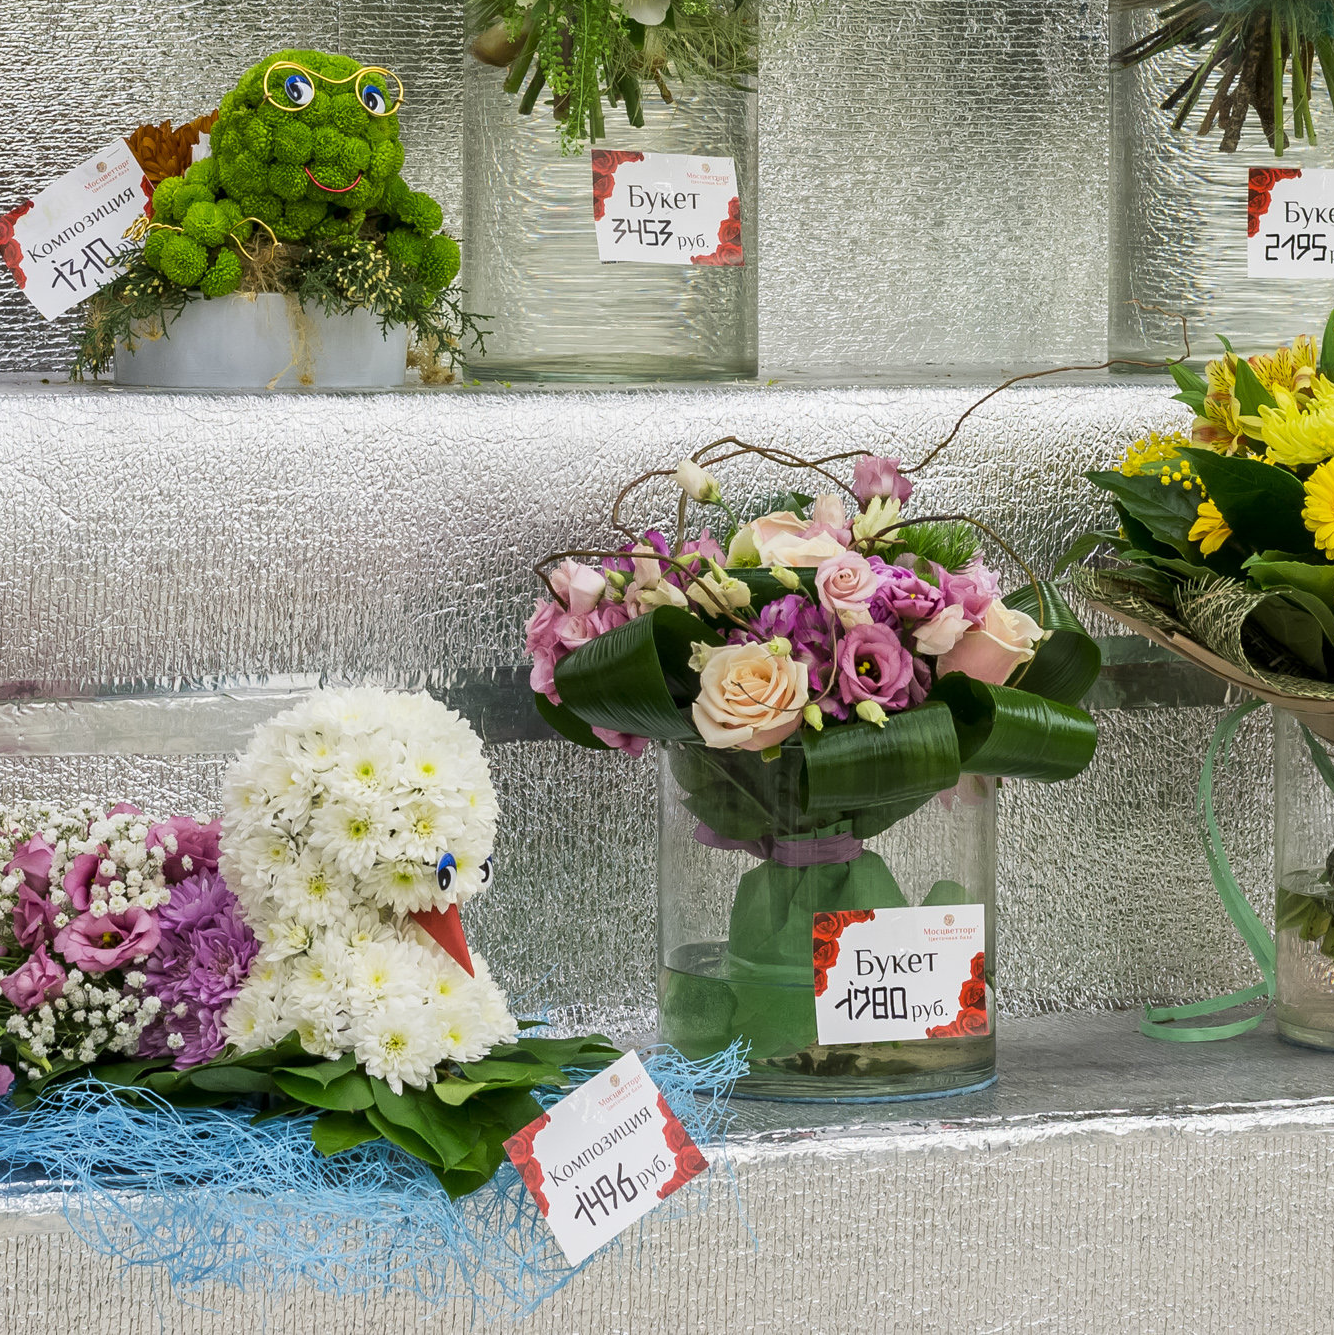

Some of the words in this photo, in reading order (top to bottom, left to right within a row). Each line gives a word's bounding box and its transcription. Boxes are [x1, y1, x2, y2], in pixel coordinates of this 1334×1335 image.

[627, 185, 700, 214] Букет
[27, 186, 135, 263] Композиция
[611, 219, 673, 246] 3453
[677, 234, 709, 251] руб.
[1265, 234, 1327, 261] 2195
[854, 949, 938, 982] Букет
[911, 999, 948, 1022] руб.
[547, 1106, 652, 1187] Композиция
[635, 1154, 671, 1190] руб.
